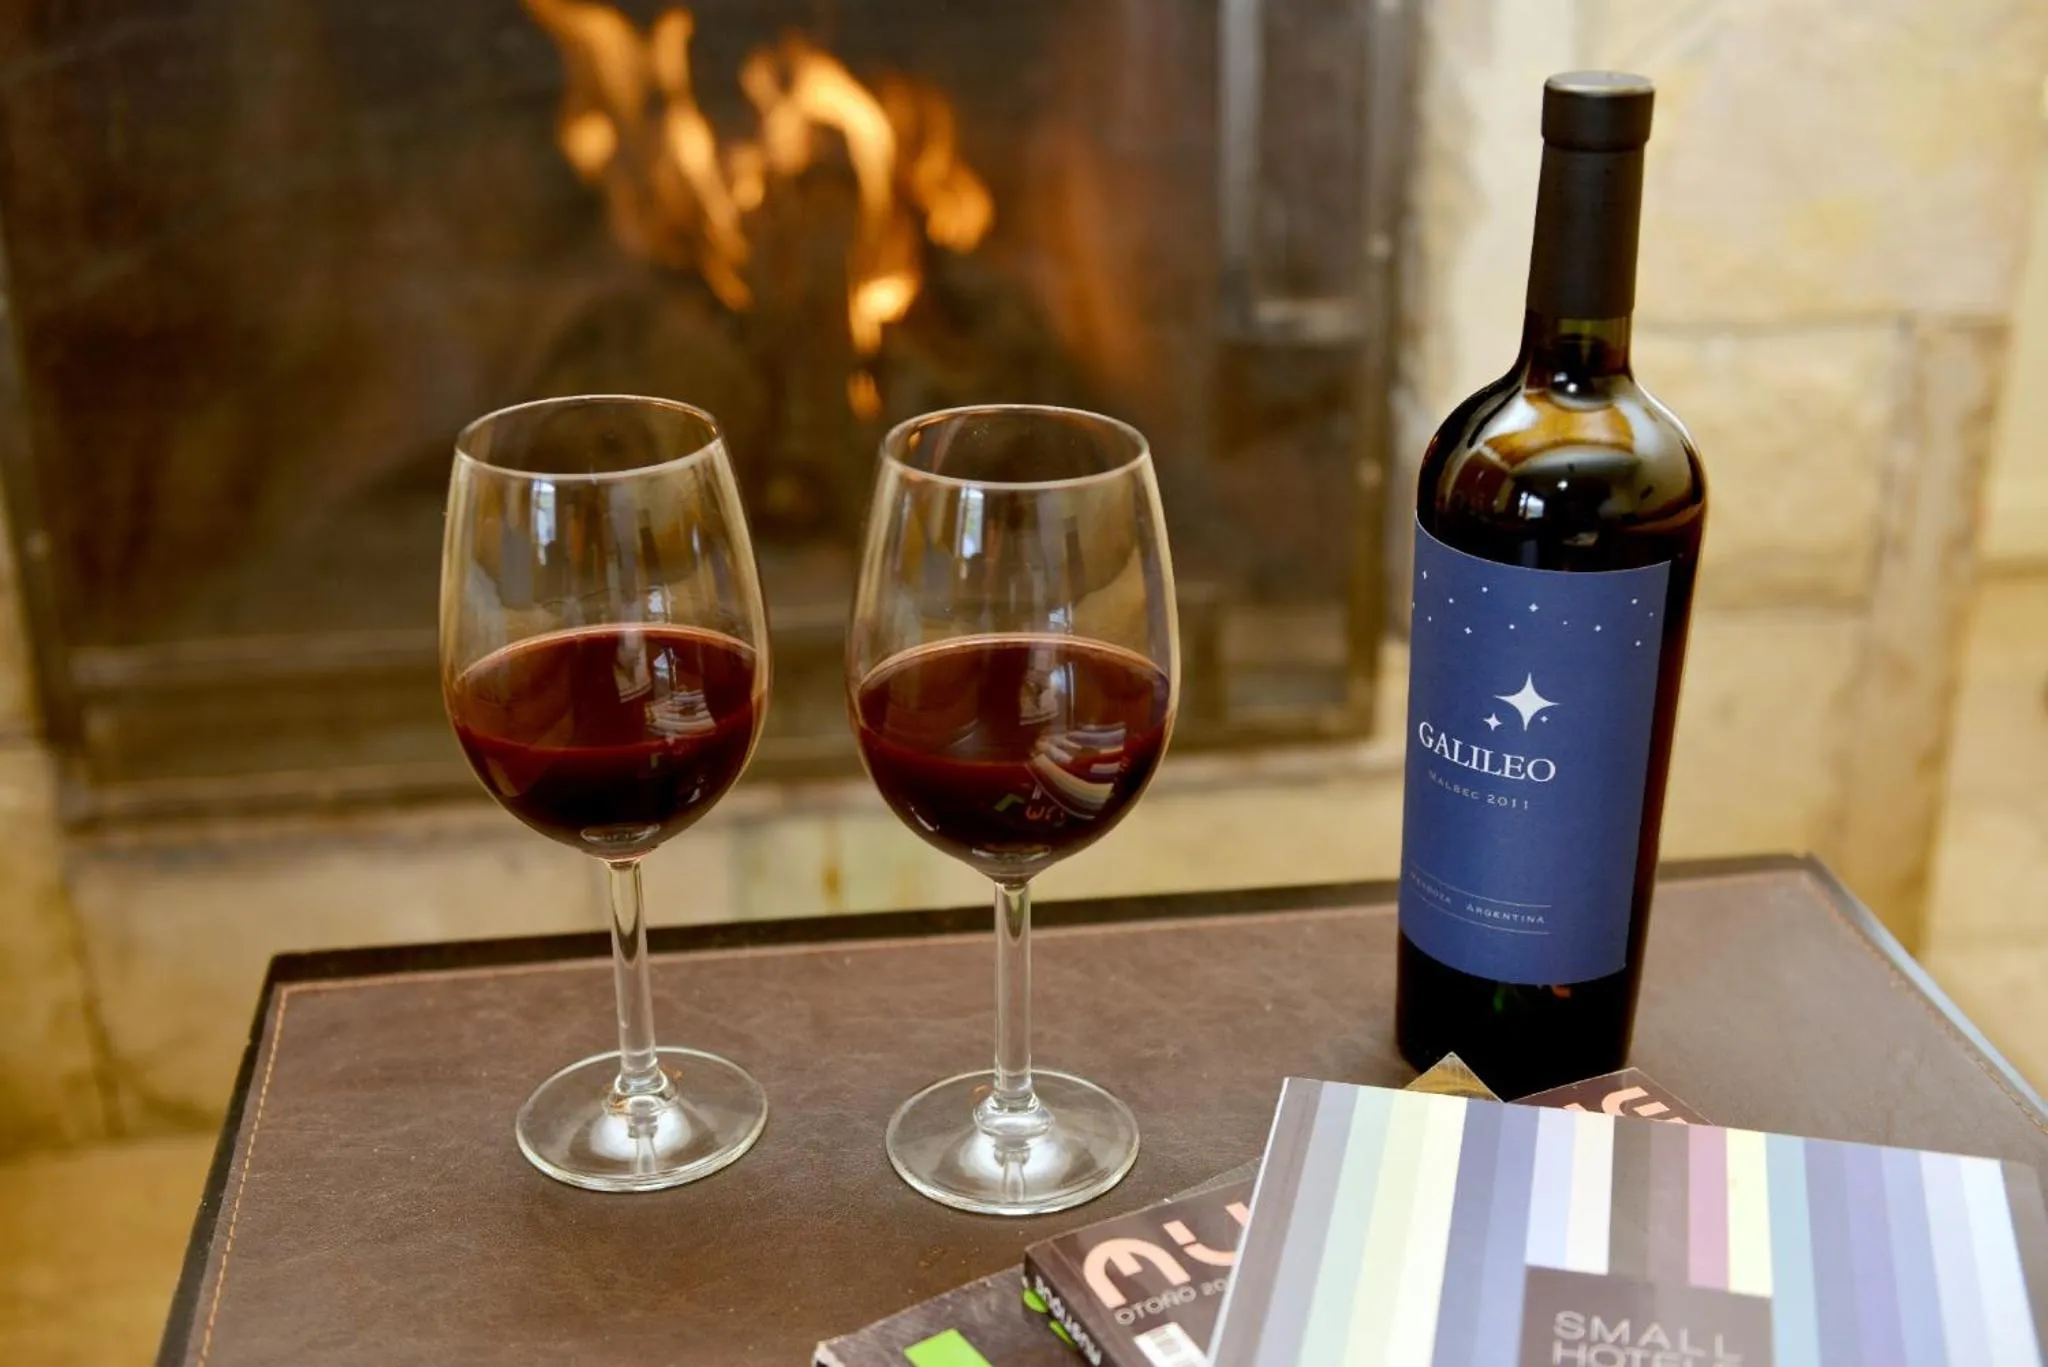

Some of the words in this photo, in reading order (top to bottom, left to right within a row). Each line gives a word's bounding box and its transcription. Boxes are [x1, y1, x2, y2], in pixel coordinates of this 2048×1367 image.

[1419, 721, 1557, 782] GALILEO
[1428, 769, 1480, 800] MALBEC
[1486, 794, 1529, 810] 2011
[1465, 902, 1545, 924] ARGENTINA
[1553, 1310, 1744, 1362] SMALL
